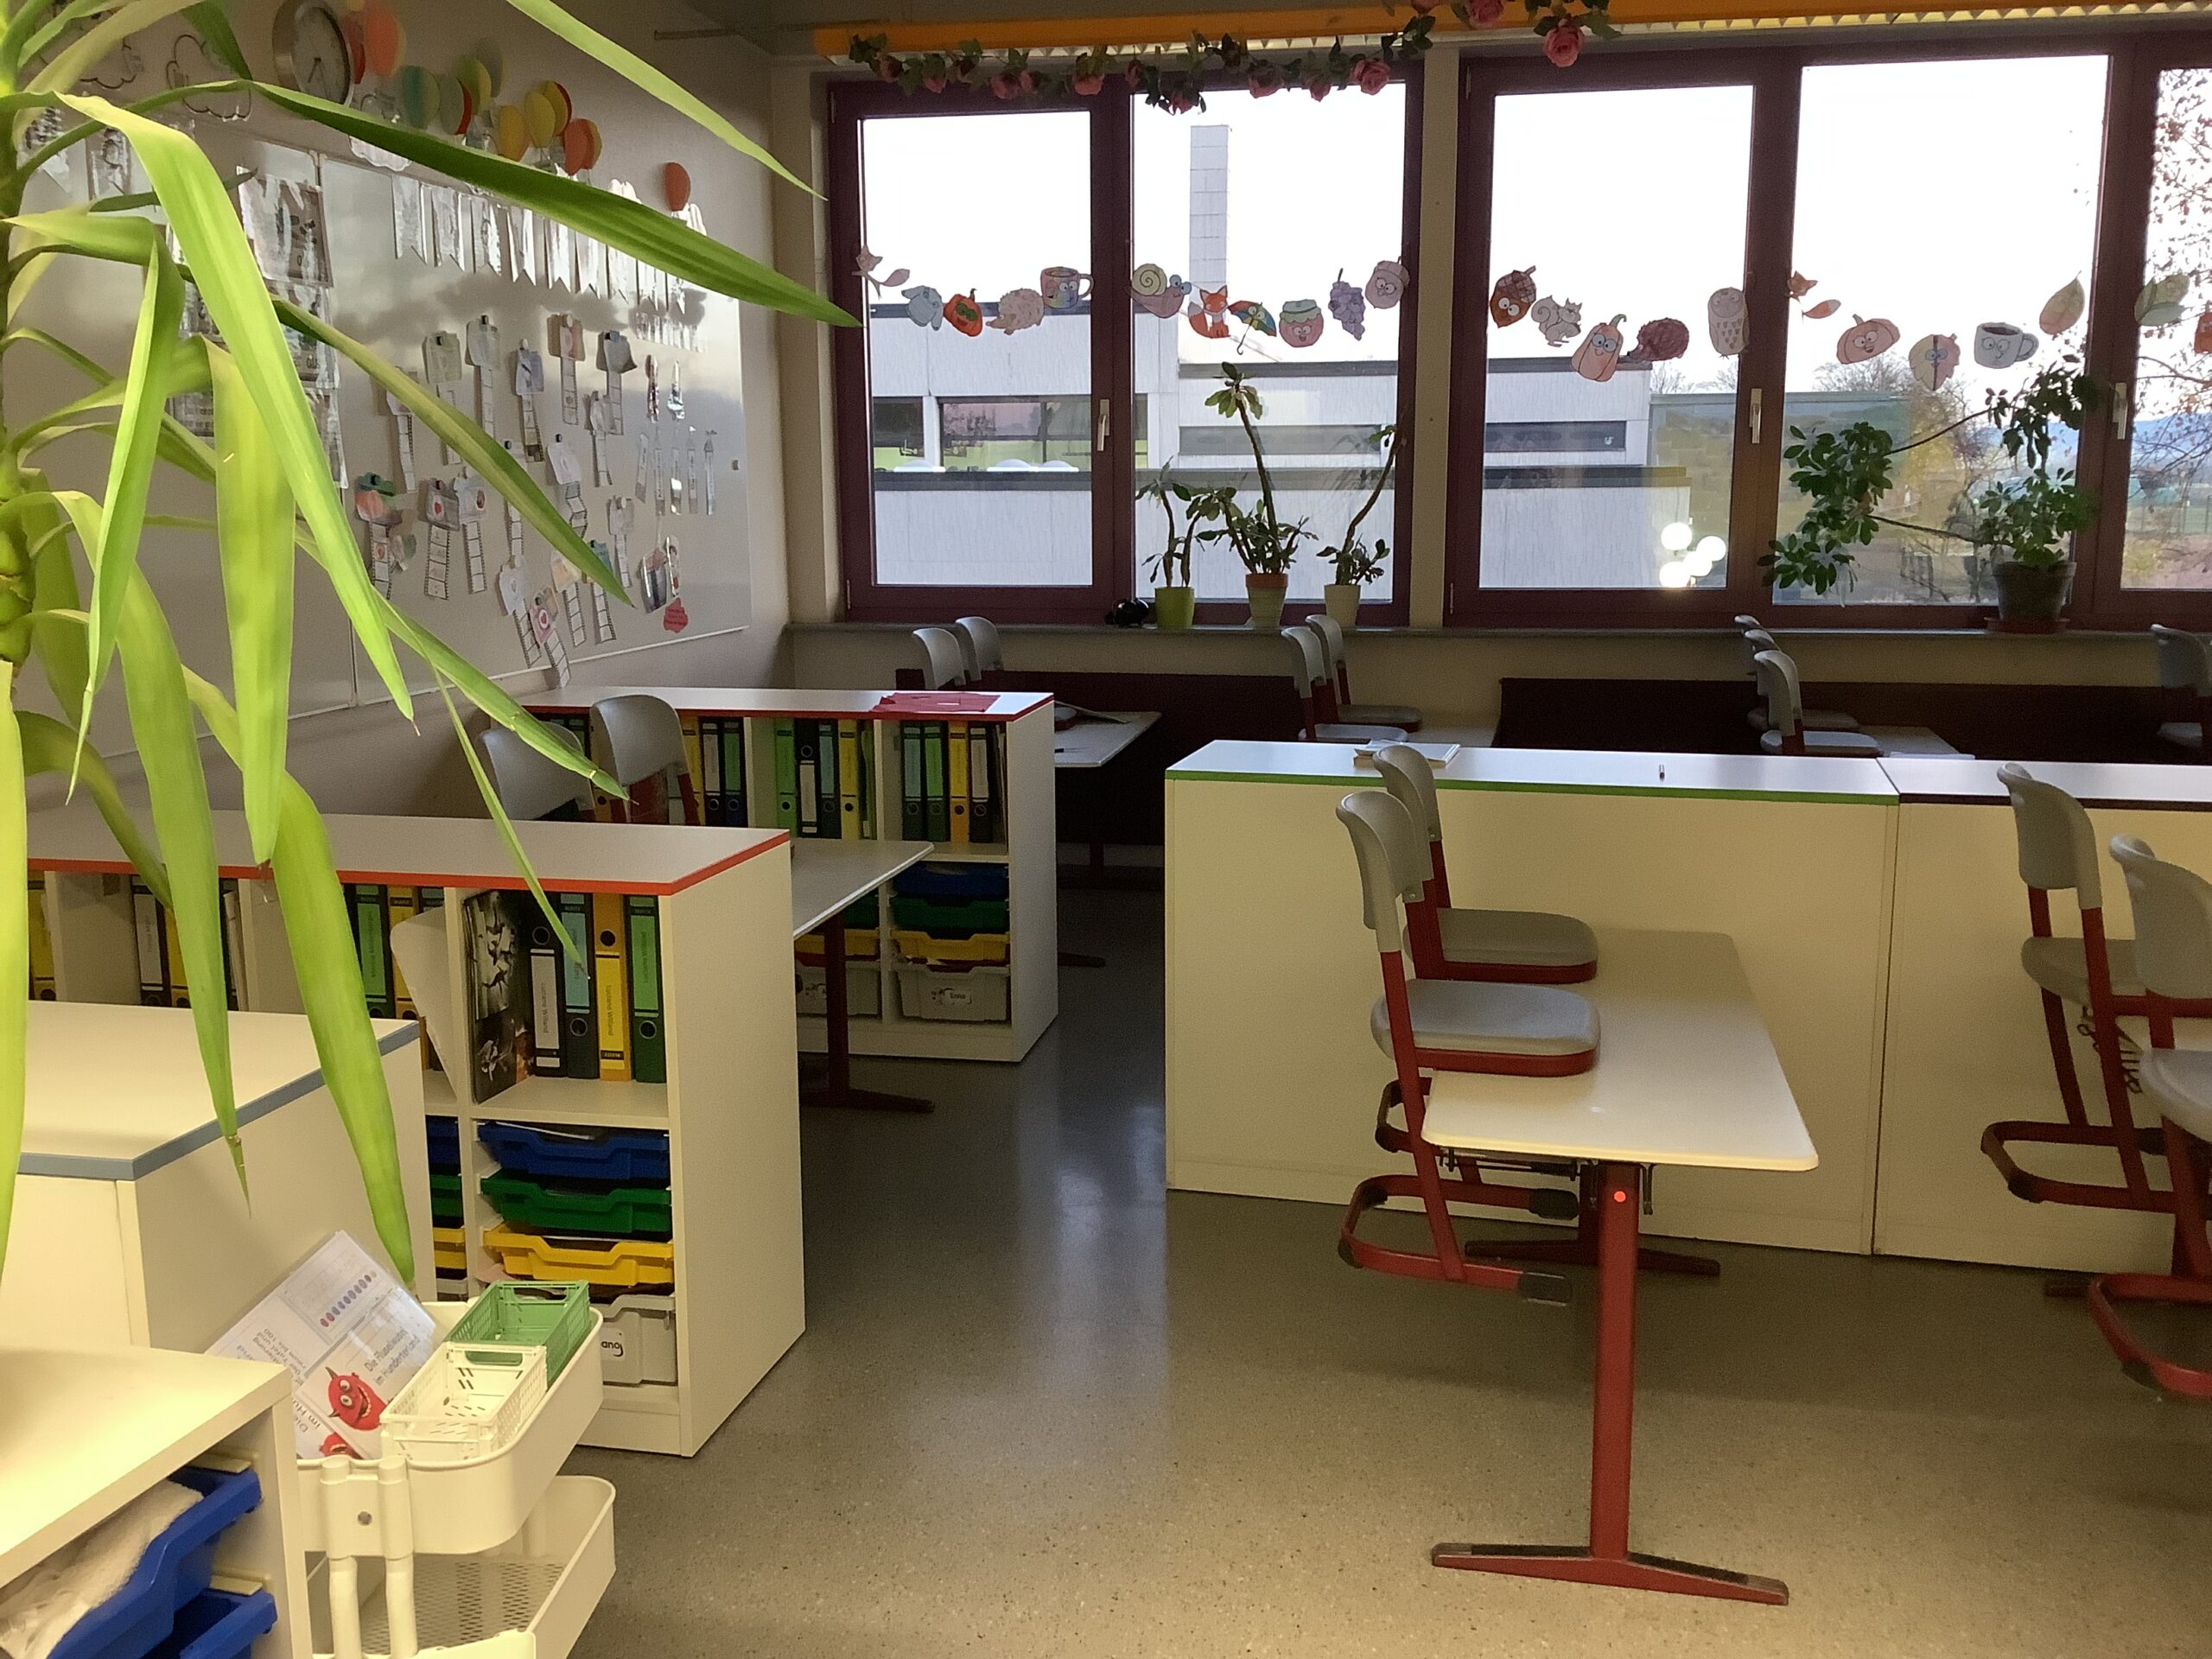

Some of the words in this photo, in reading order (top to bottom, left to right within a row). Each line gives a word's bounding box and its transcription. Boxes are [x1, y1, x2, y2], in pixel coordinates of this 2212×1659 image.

[264, 1328, 276, 1342] 100
[364, 1358, 378, 1372] Die
[308, 1414, 321, 1430] im
